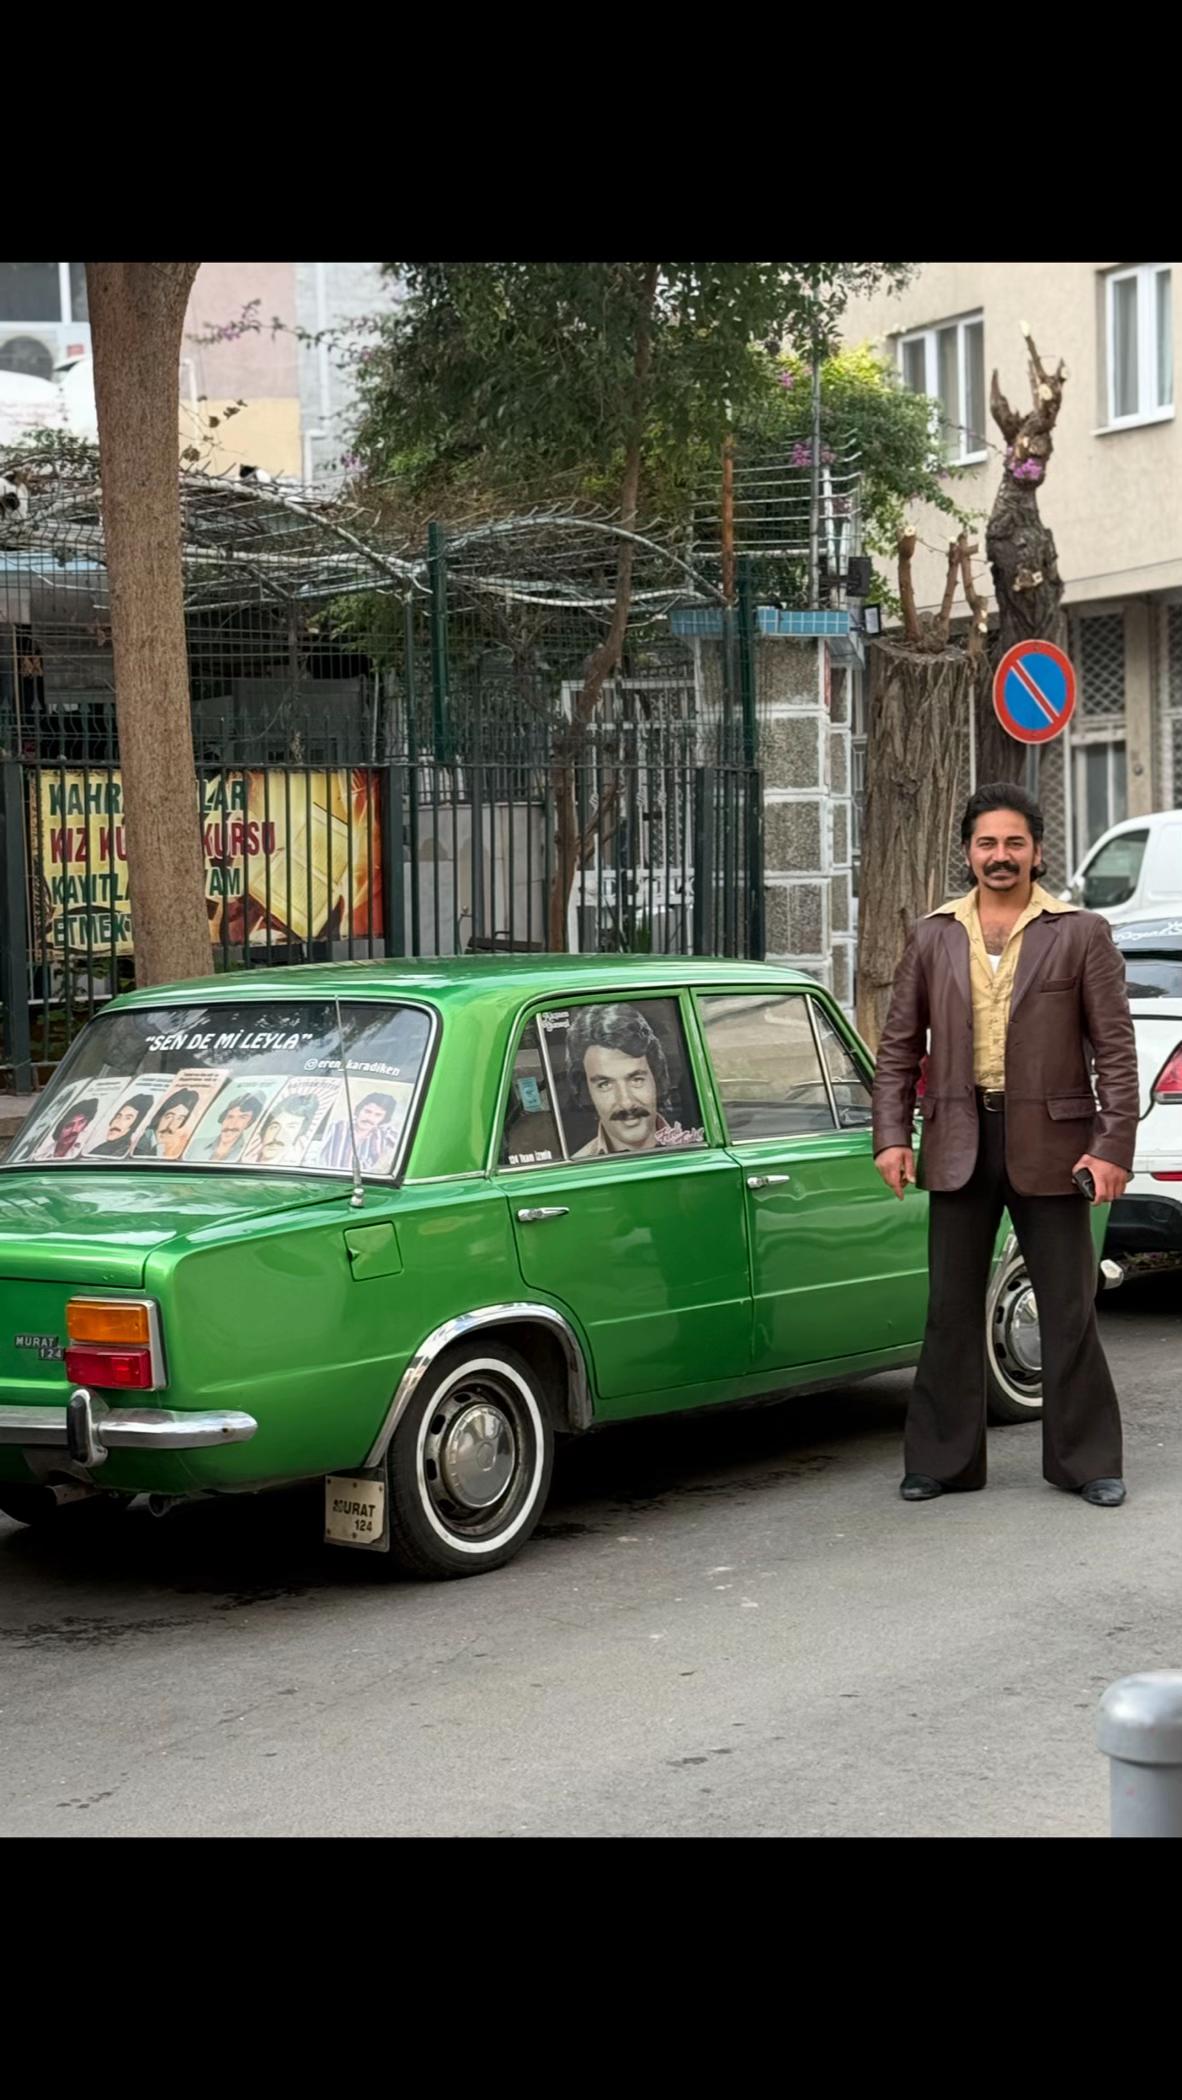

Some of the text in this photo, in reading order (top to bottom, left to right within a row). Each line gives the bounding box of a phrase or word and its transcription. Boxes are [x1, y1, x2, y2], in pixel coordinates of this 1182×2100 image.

[186, 1033, 216, 1050] DE
[213, 1029, 244, 1049] Mİ
[15, 1336, 54, 1347] MURAT
[40, 1348, 62, 1358] 124
[355, 1519, 373, 1532] 124
